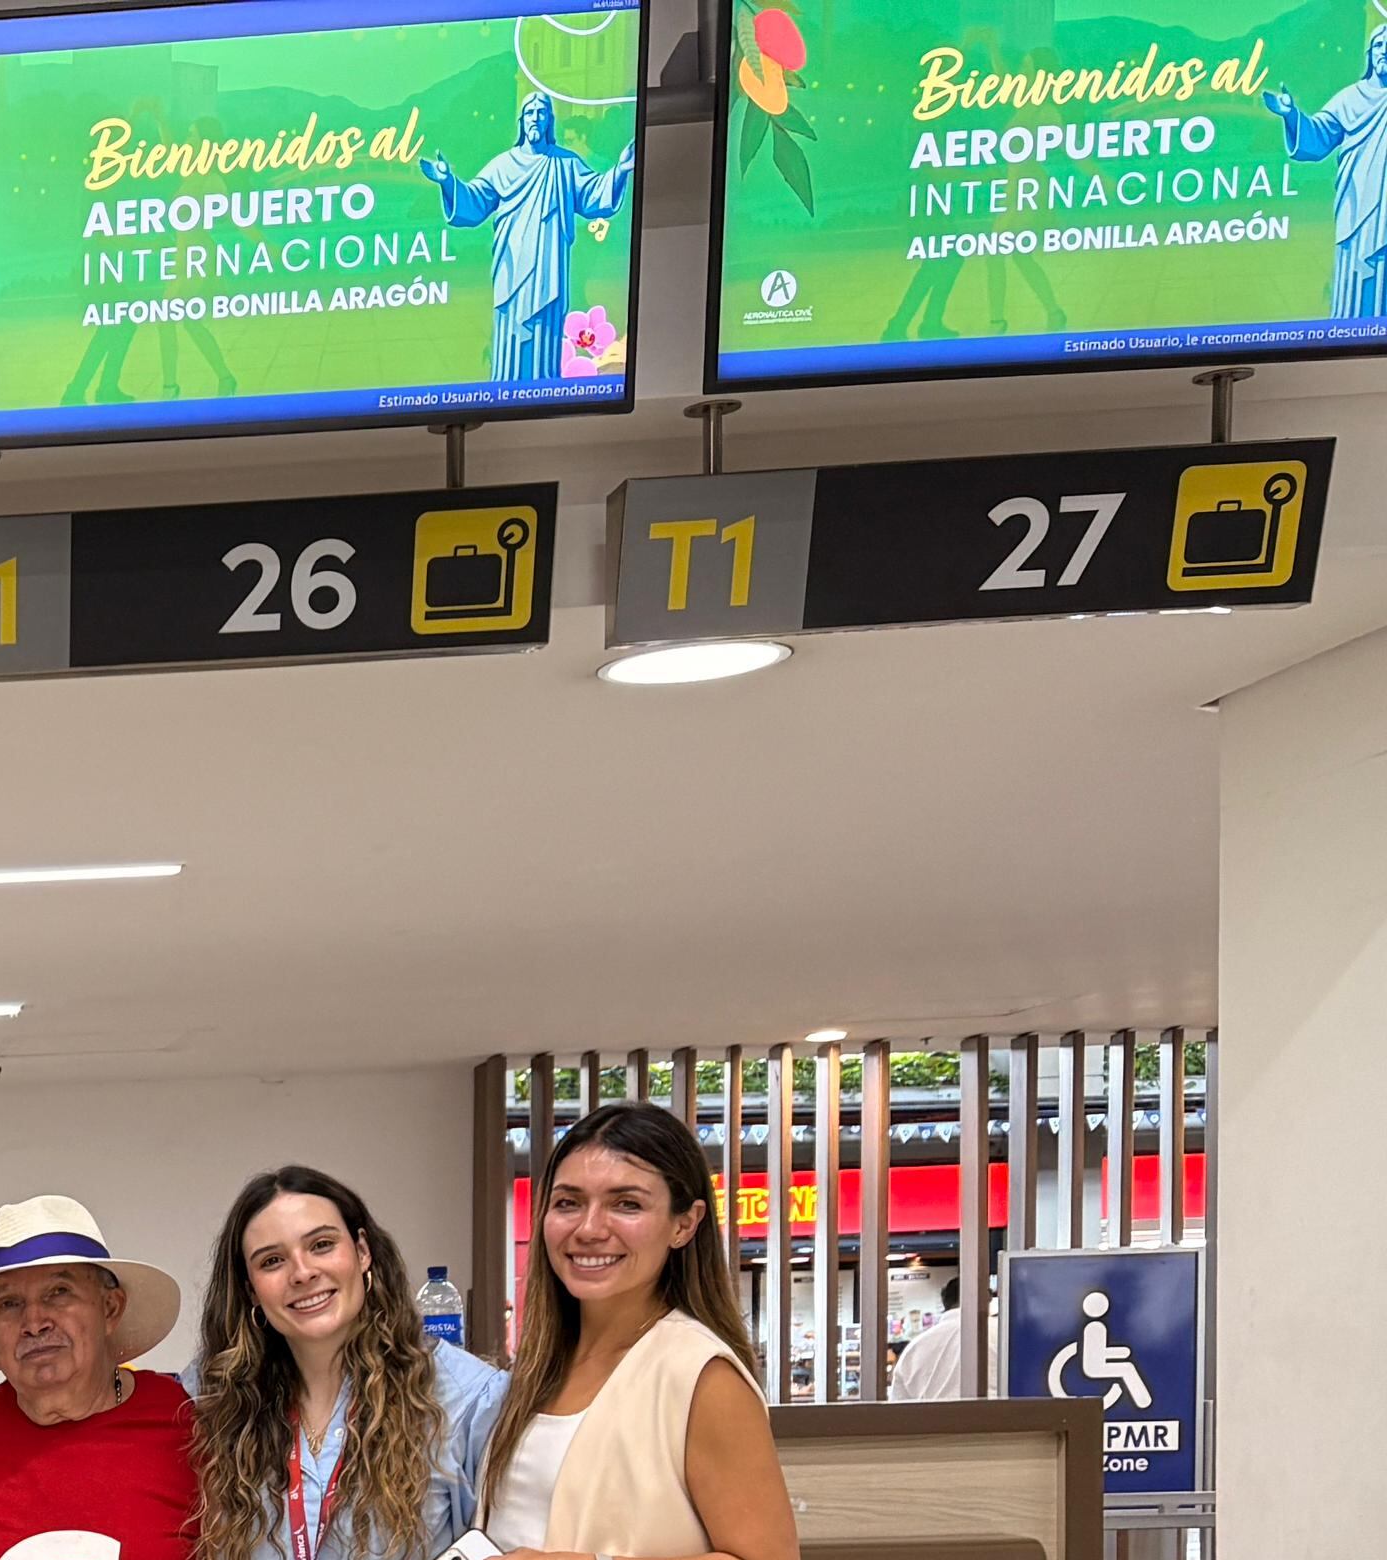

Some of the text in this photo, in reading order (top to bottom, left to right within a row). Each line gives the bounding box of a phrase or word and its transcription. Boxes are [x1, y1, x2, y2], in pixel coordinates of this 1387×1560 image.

[913, 38, 1268, 121] Bienvenidos al
[83, 107, 424, 191] Bienvenidos al
[909, 115, 1215, 169] AEROPUERTO
[82, 183, 375, 238] AEROPUERTO
[909, 163, 1298, 218] INTERNACIONAL
[83, 229, 457, 286] INTERNACIONAL
[906, 210, 1290, 260] ALFONSO BONILLA ARAGÓN
[82, 276, 448, 326] ALFONSO BONILLA ARAGÓN
[1064, 338, 1125, 352] Estimado
[1129, 335, 1183, 349] Usuario,
[1186, 333, 1199, 346] le
[1202, 329, 1304, 345] recomendamos
[1307, 328, 1325, 340] no
[378, 393, 438, 408] Estimado
[441, 389, 494, 404] Usuario,
[498, 387, 509, 401] le
[512, 383, 613, 400] recomendamos
[648, 491, 1127, 611] T1 27
[218, 537, 358, 634] 26
[423, 1322, 457, 1332] CRISTAL
[1107, 1425, 1169, 1448] PMR
